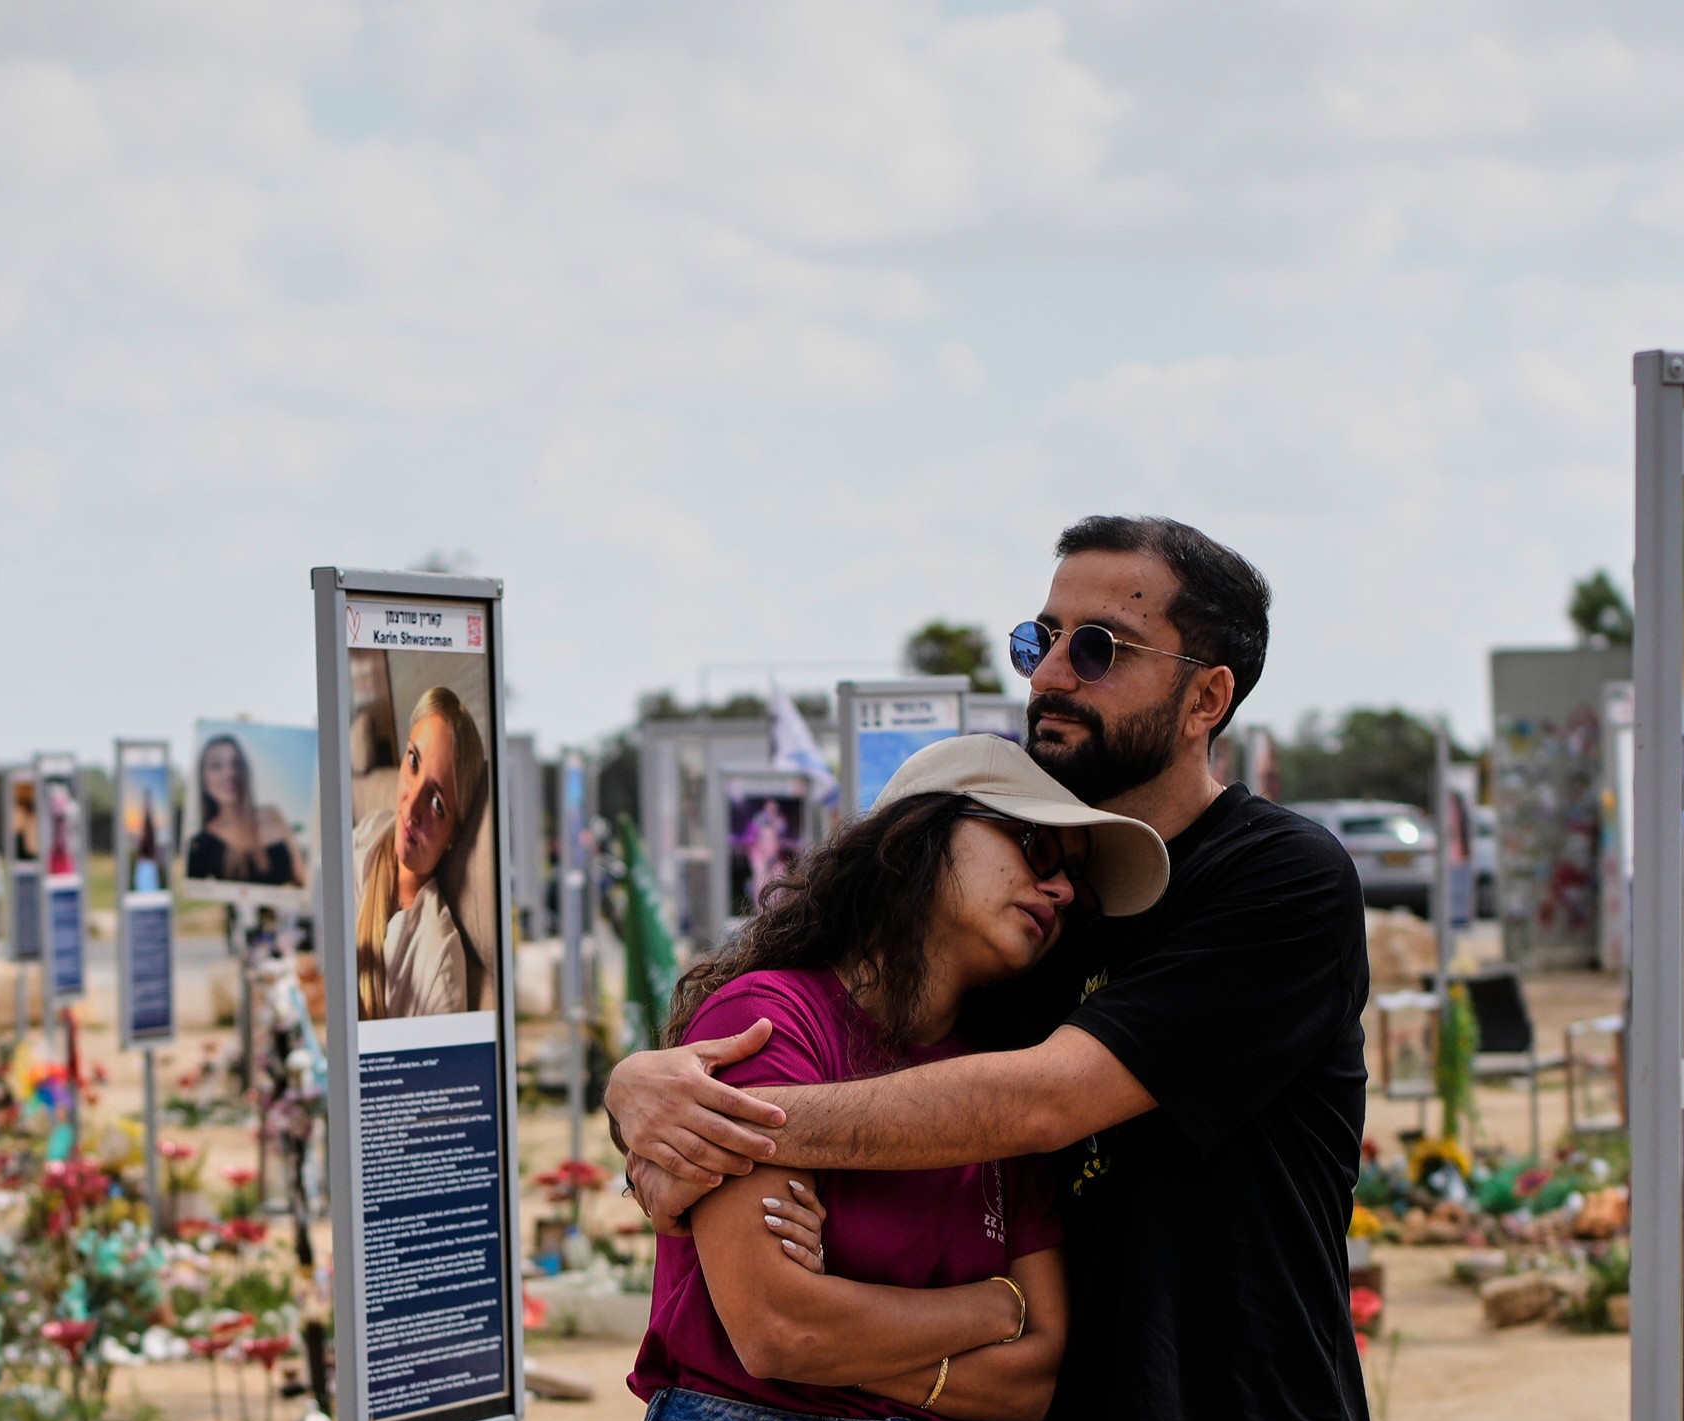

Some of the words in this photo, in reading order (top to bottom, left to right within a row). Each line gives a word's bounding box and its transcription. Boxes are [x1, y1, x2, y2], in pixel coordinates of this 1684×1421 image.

[385, 610, 417, 626] שוורצמן
[420, 612, 442, 628] קארין
[373, 630, 397, 644] Karin
[400, 632, 453, 647] Shwarcman
